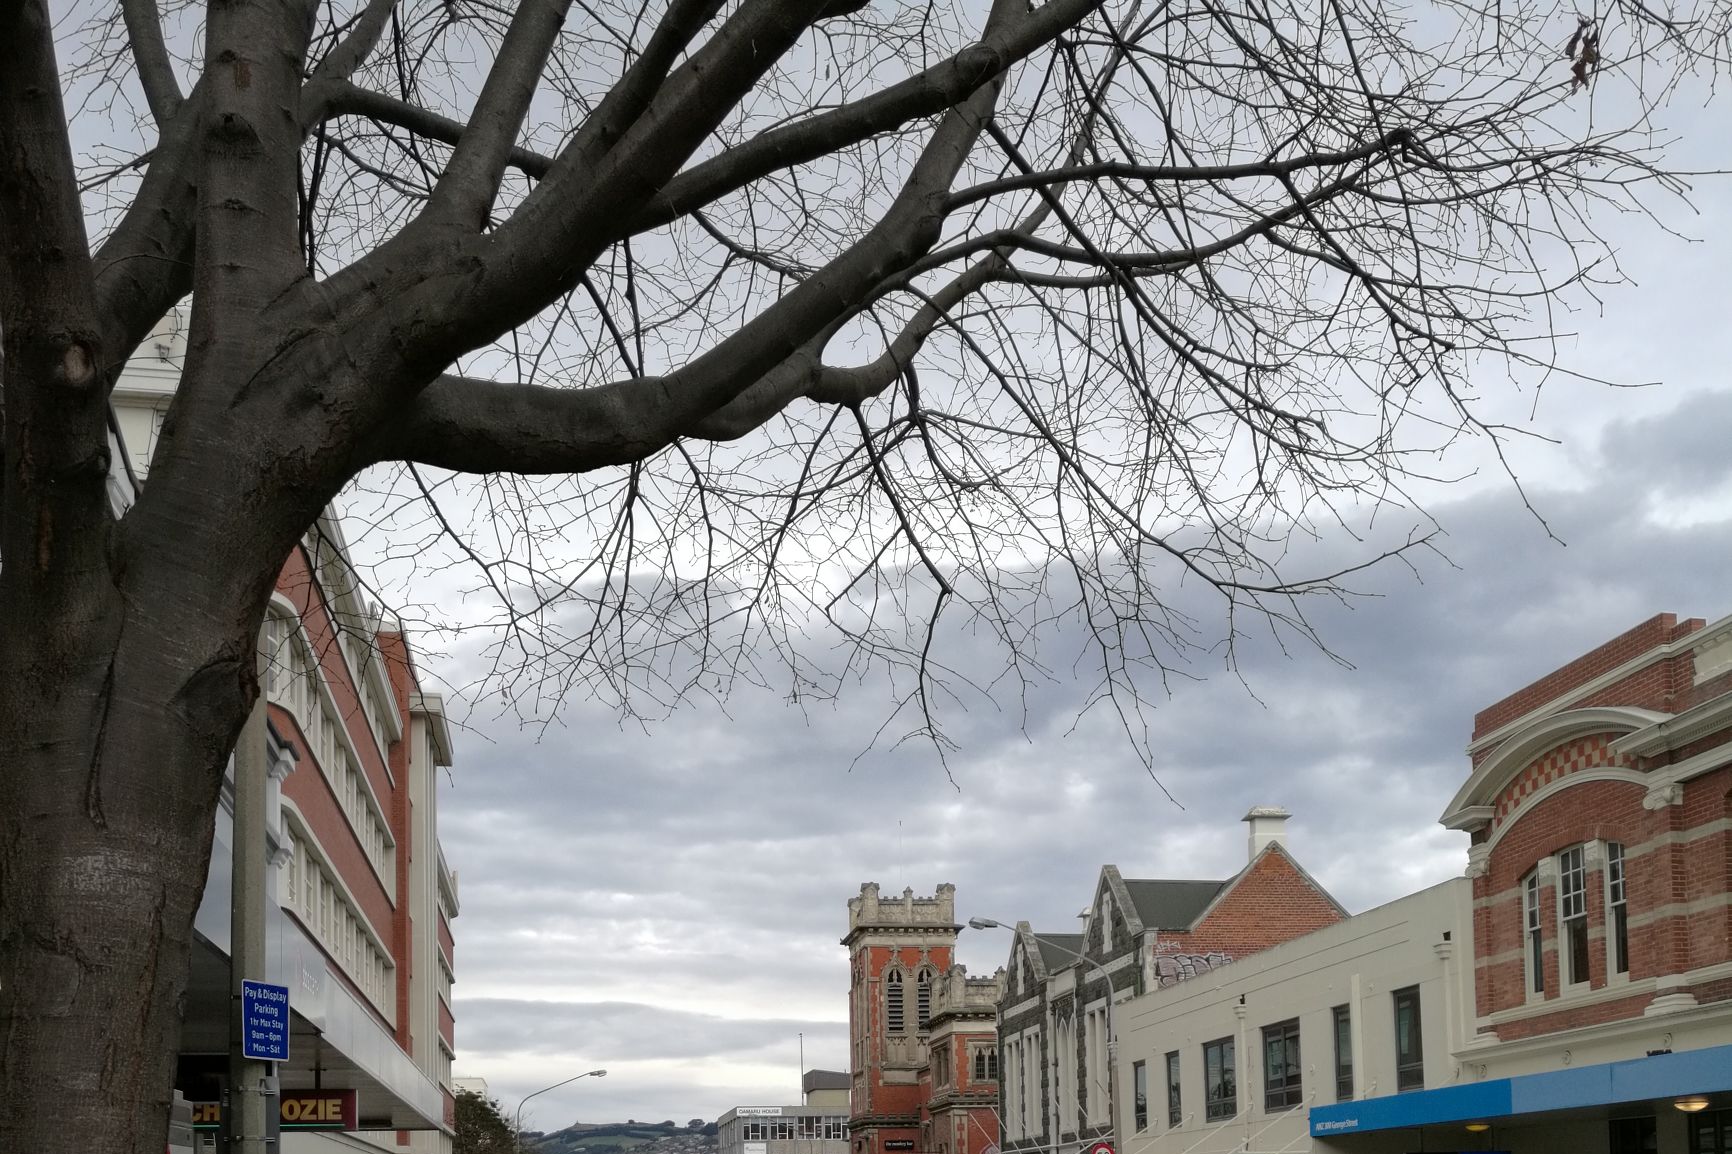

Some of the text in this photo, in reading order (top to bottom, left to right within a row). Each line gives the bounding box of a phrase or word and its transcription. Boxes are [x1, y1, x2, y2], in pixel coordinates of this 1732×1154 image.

[244, 986, 287, 1004] Pay & Display
[254, 1002, 279, 1017] Parking
[260, 1018, 271, 1028] Max
[271, 1020, 284, 1031] Stay
[251, 1030, 265, 1040] 9am
[268, 1032, 282, 1042] 6pm
[252, 1043, 266, 1052] Mon
[269, 1045, 281, 1054] Sat
[280, 1098, 342, 1121] OZIE
